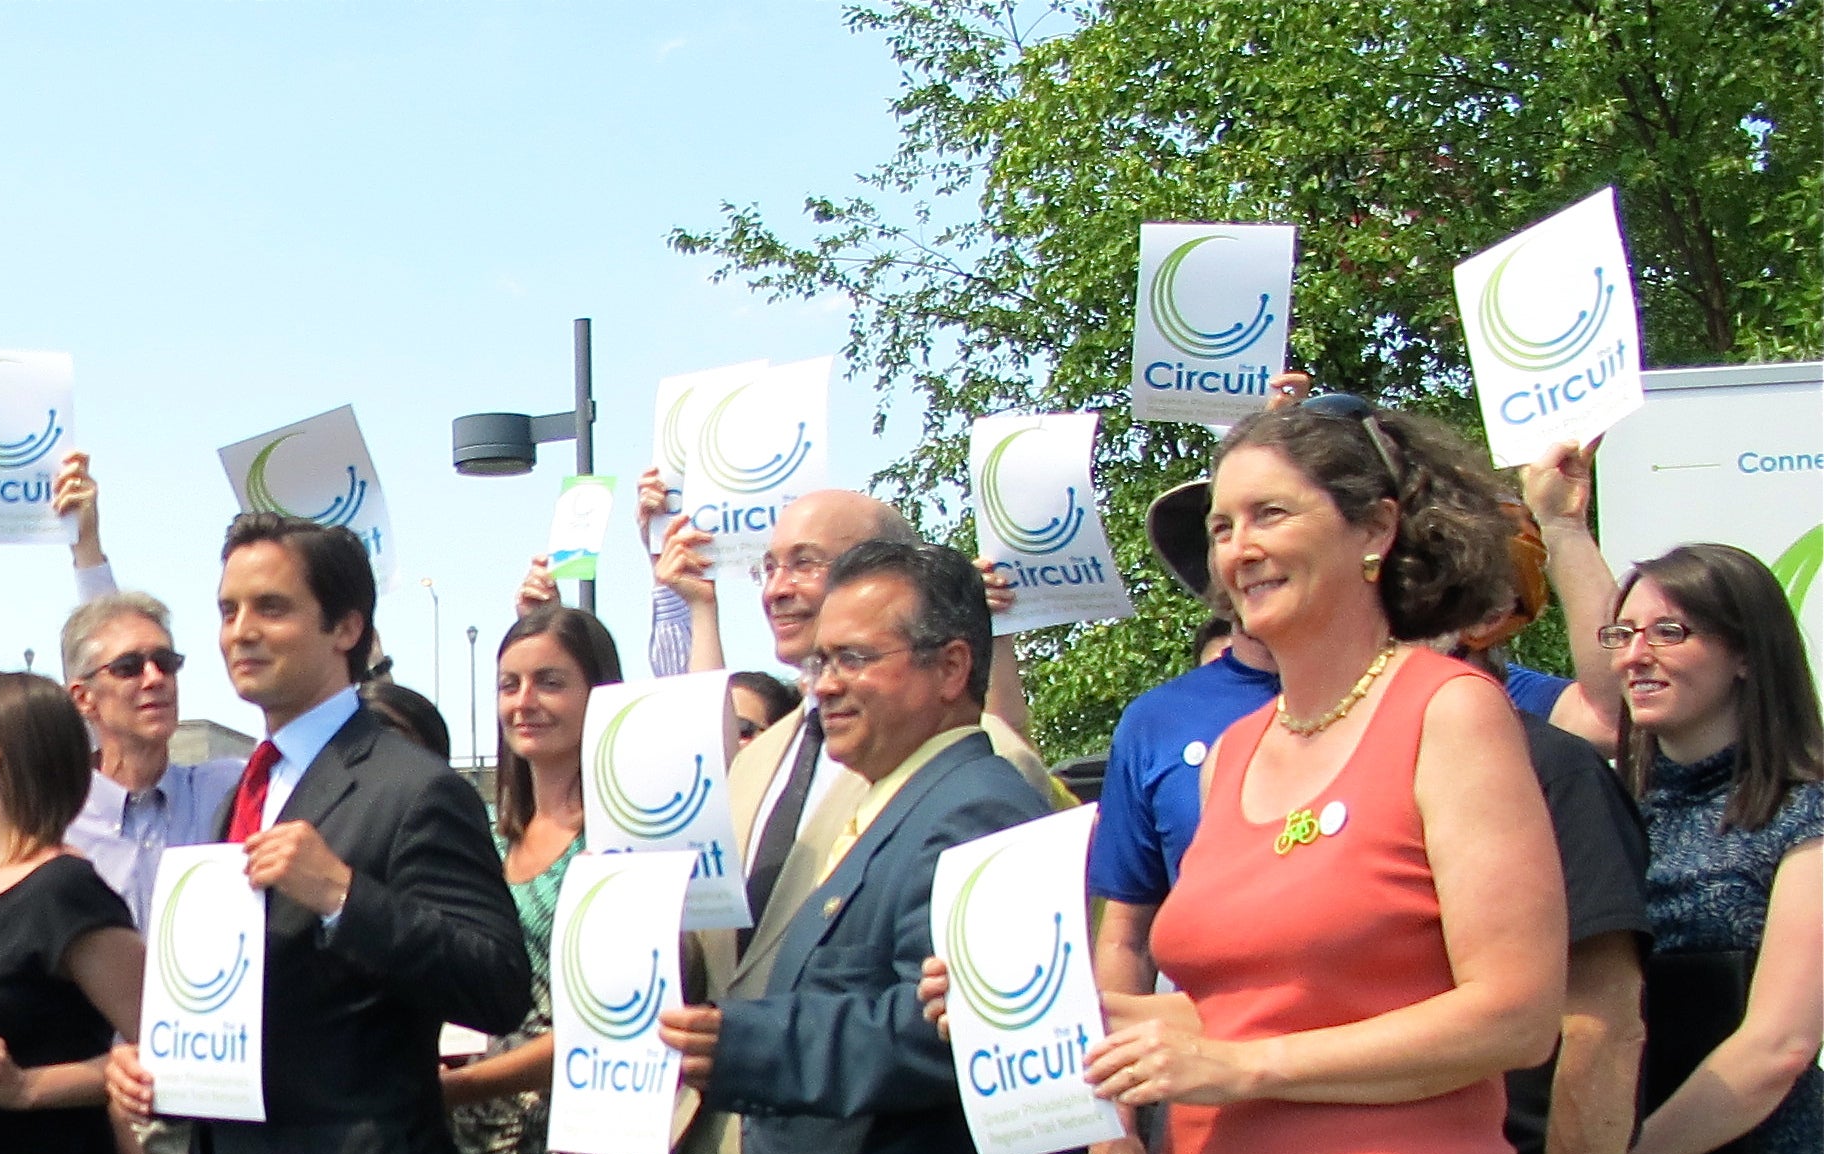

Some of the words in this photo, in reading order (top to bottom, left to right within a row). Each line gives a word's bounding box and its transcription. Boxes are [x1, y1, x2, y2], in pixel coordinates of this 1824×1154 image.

[1144, 361, 1270, 395] Circuit
[1500, 338, 1625, 425] Circuit
[690, 501, 777, 535] Circ
[992, 556, 1106, 589] Circuit
[150, 1020, 247, 1063] Circuit
[970, 1024, 1088, 1096] Circuit
[566, 1047, 669, 1093] Circuit
